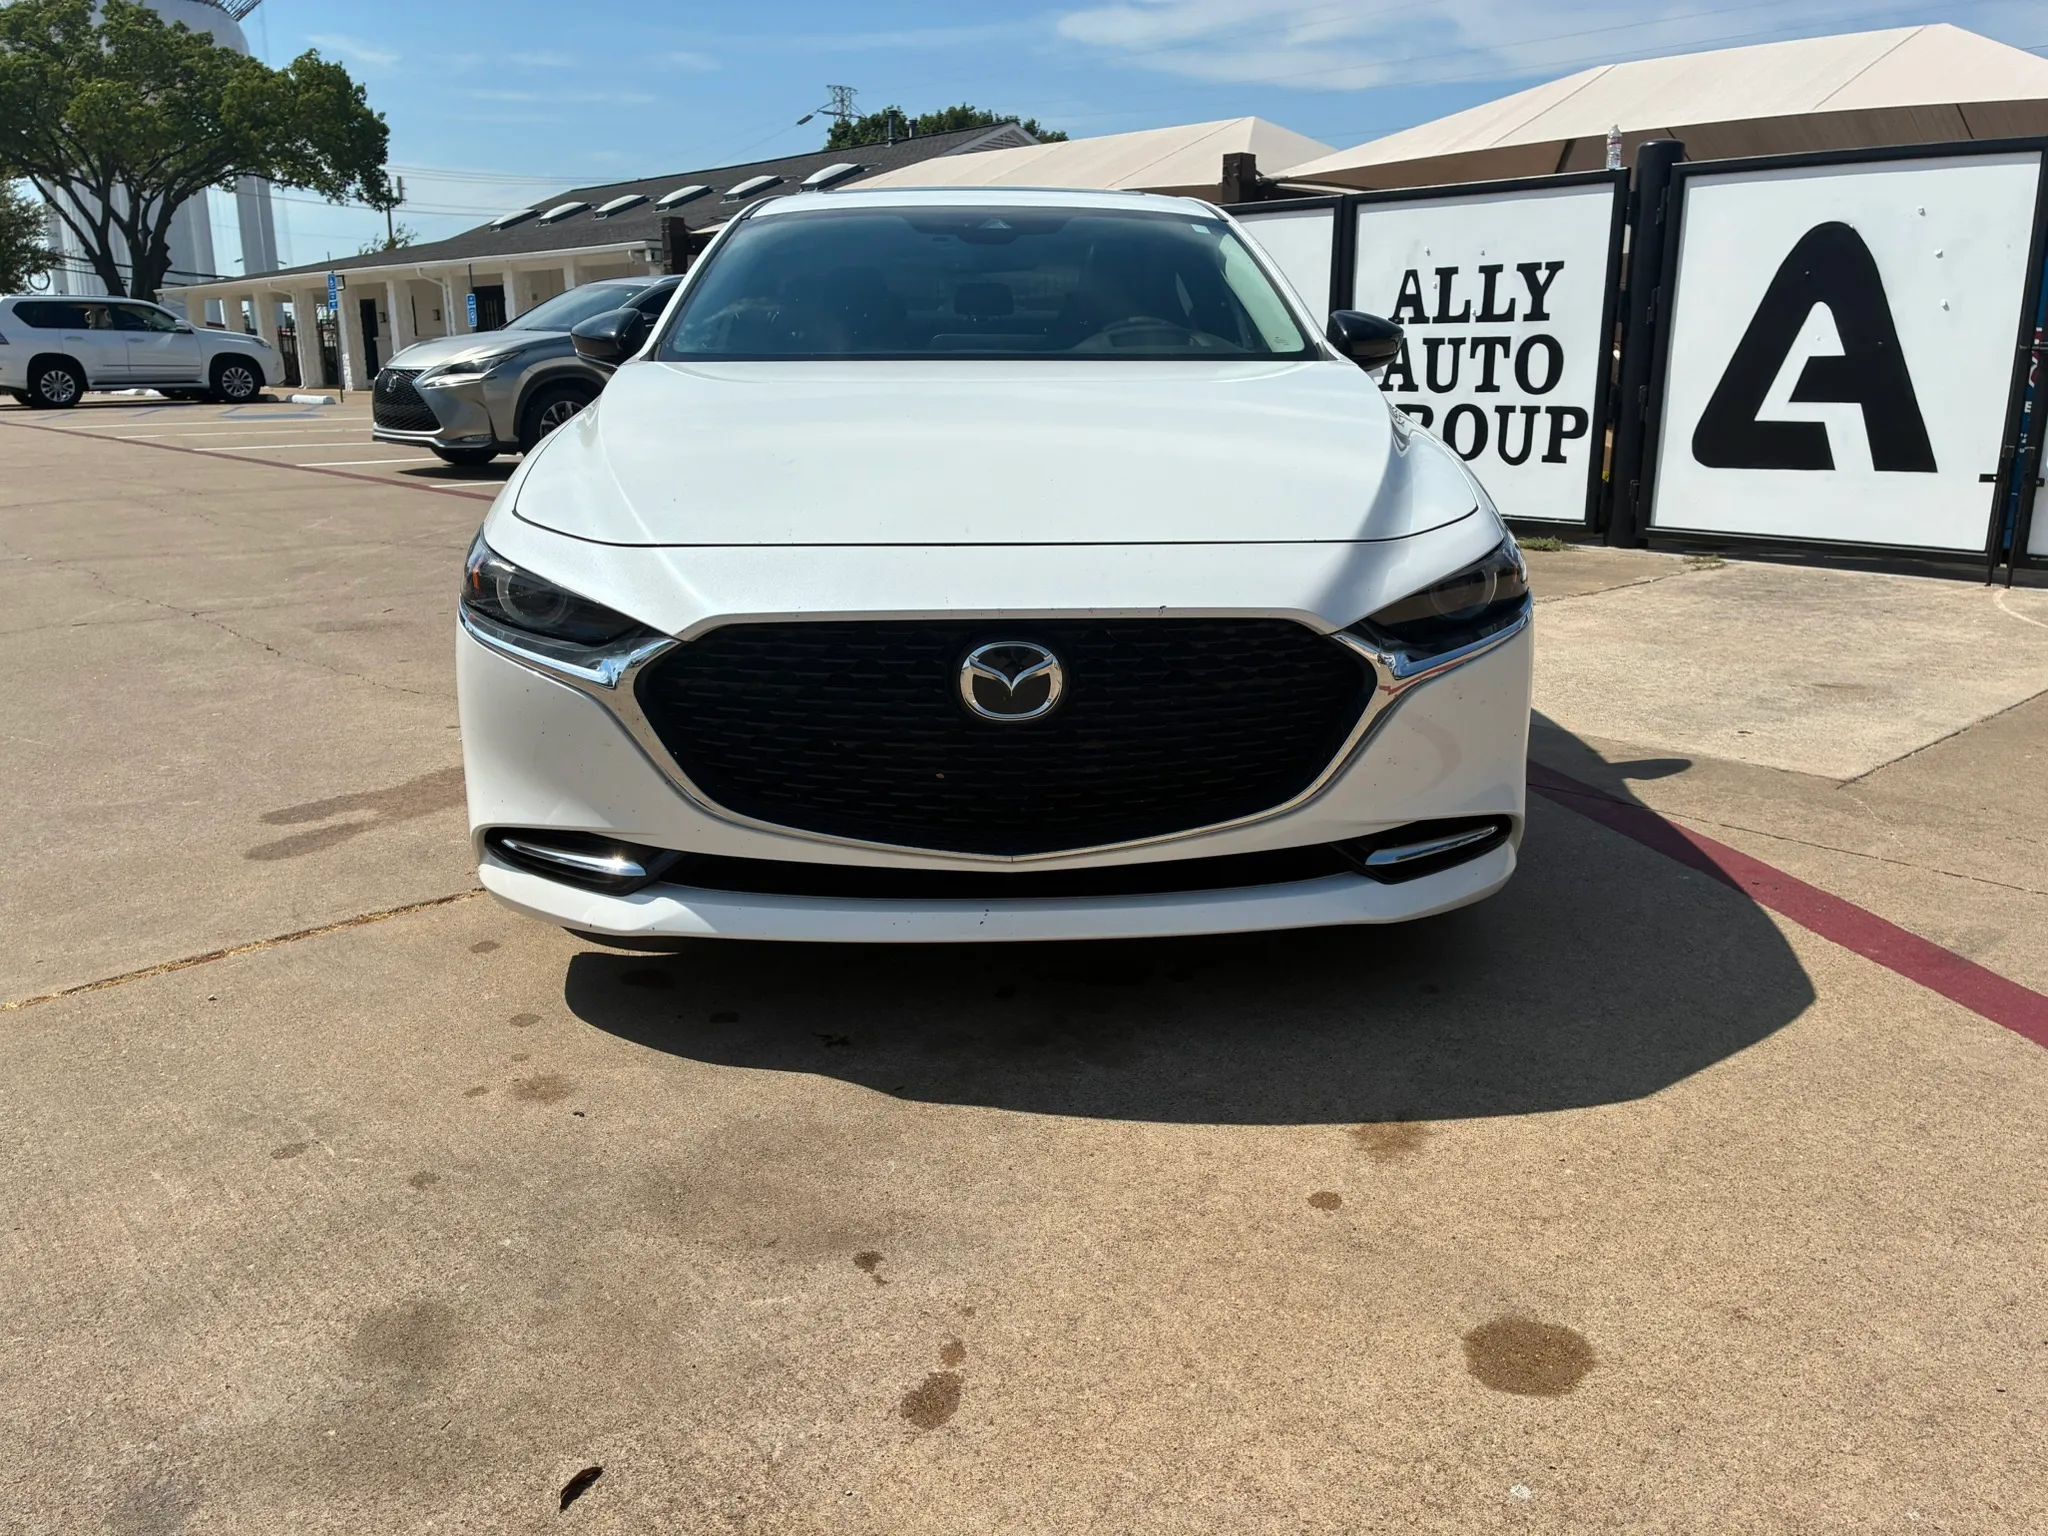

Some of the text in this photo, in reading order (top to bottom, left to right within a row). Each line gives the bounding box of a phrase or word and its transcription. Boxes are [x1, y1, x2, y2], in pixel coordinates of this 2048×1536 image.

[1388, 260, 1565, 325] ALLY
[1378, 334, 1564, 396] AUTO
[1395, 402, 1590, 466] OUP
